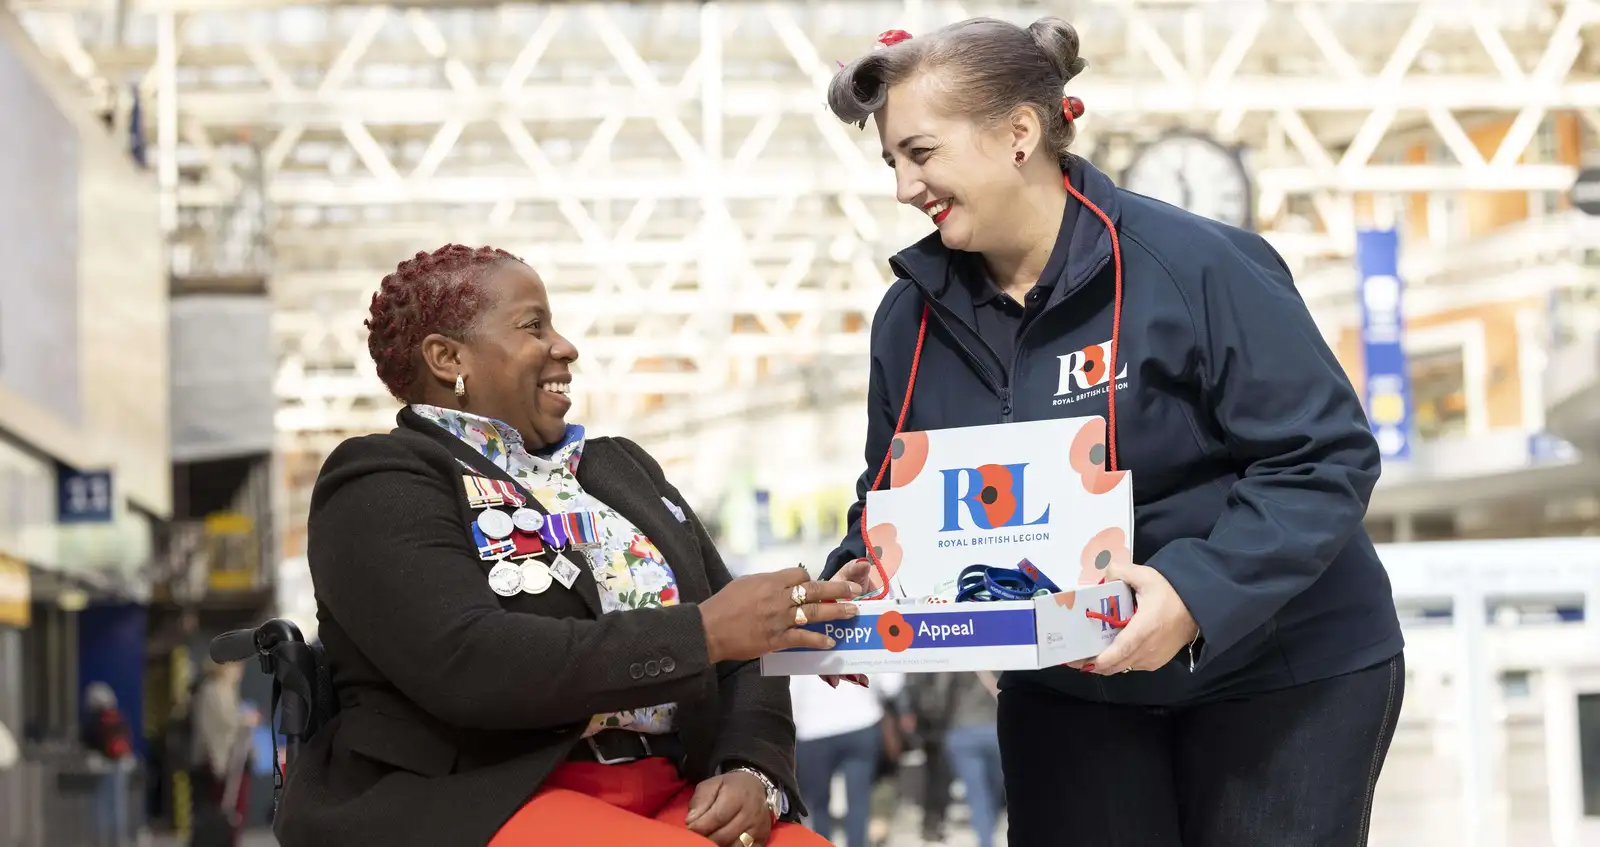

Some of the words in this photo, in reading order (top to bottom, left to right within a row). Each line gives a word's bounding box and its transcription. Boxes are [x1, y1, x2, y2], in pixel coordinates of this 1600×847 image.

[1052, 397, 1075, 406] ROYAL
[1076, 389, 1101, 402] BRITISH
[1101, 382, 1128, 394] LEION
[938, 539, 968, 548] ROYAL
[971, 535, 1010, 546] BRITISH
[1013, 533, 1050, 543] LEGION
[824, 623, 872, 643] Poppy
[918, 619, 974, 641] Appeal
